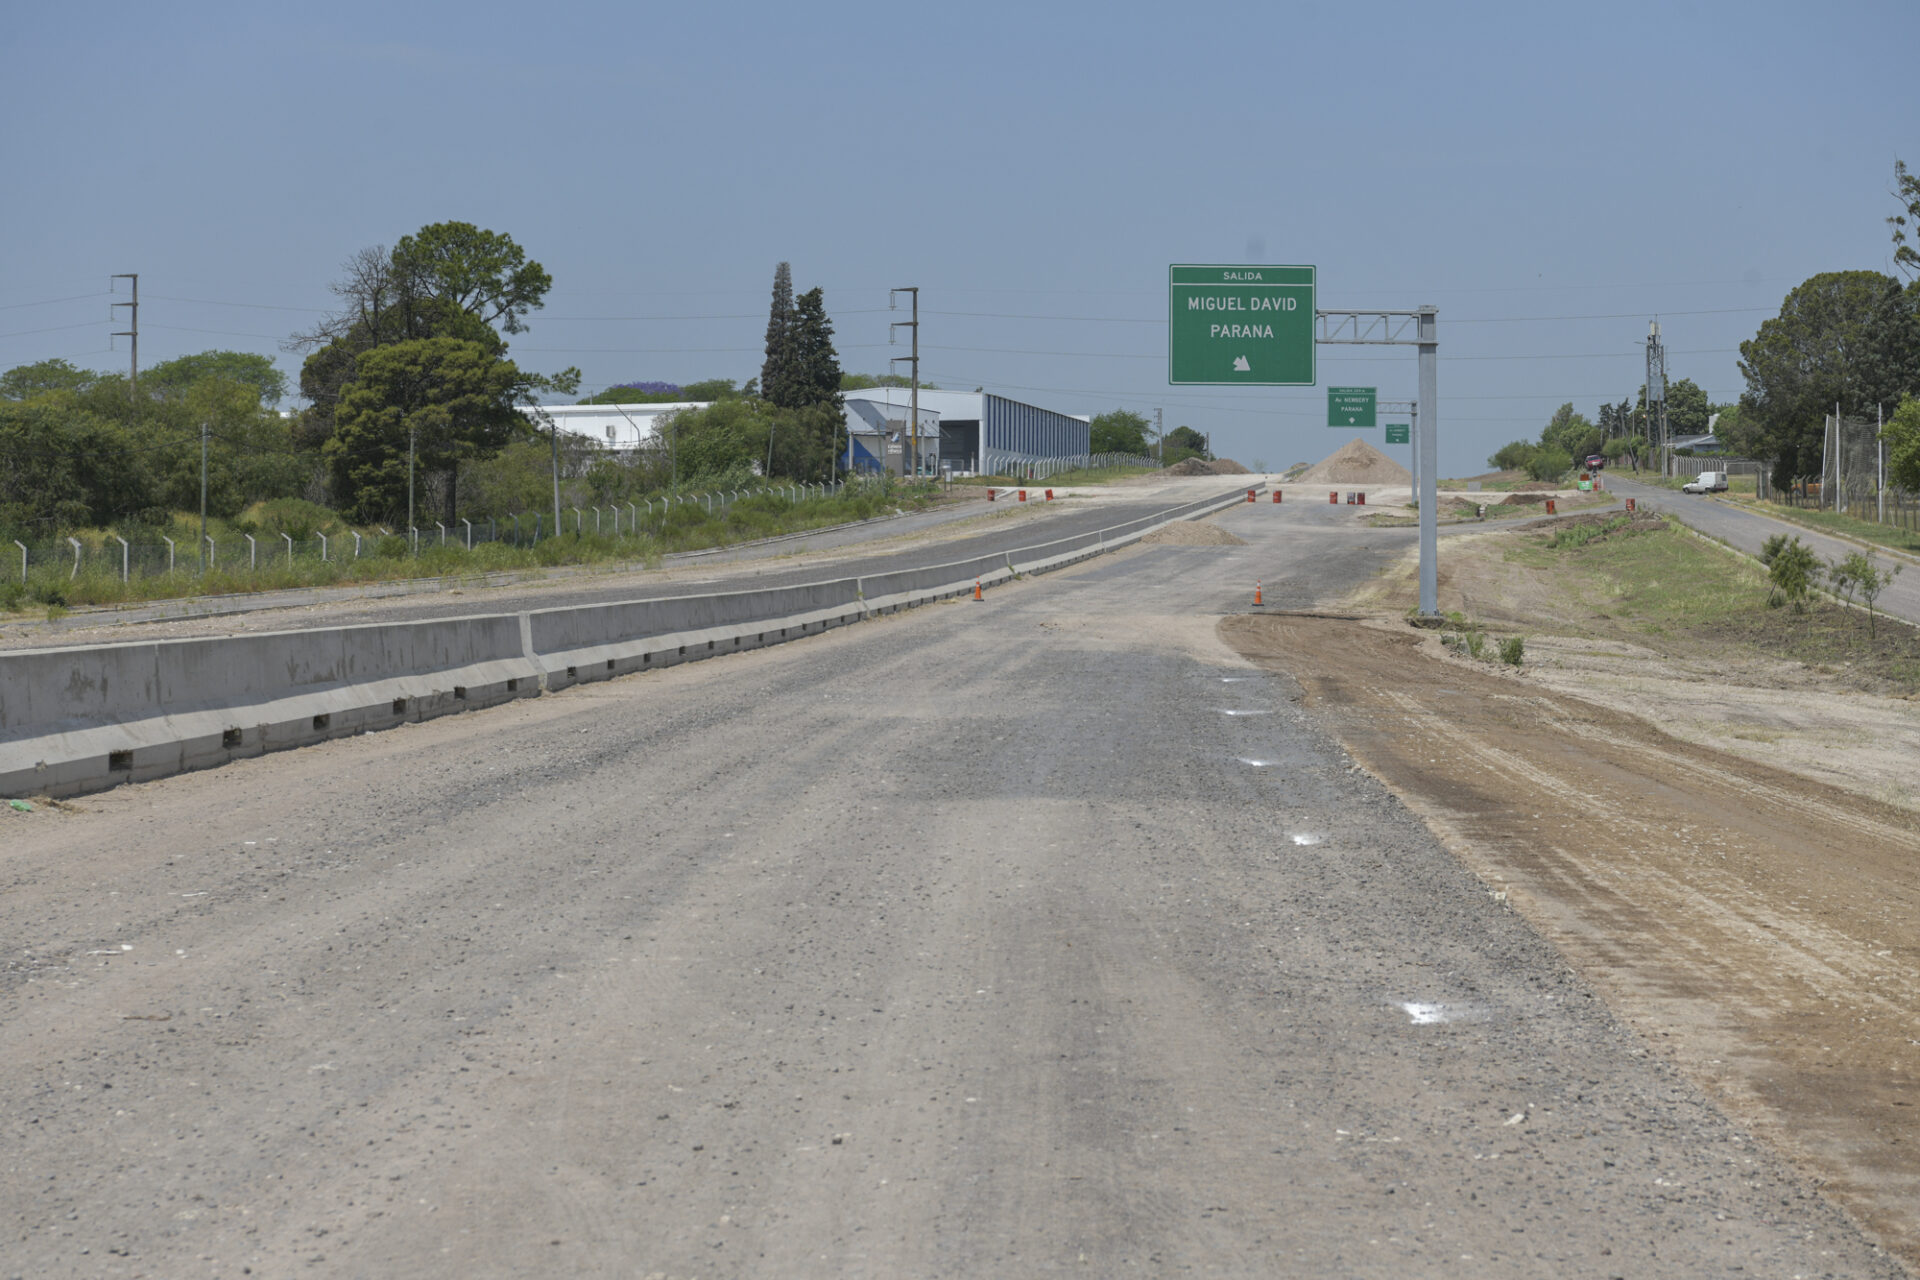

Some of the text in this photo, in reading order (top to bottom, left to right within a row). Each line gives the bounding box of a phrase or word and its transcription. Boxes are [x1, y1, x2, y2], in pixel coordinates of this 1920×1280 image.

[1223, 271, 1263, 281] SALIDA
[1187, 296, 1297, 311] MIGUEL DAVID
[1210, 324, 1274, 339] PARANA
